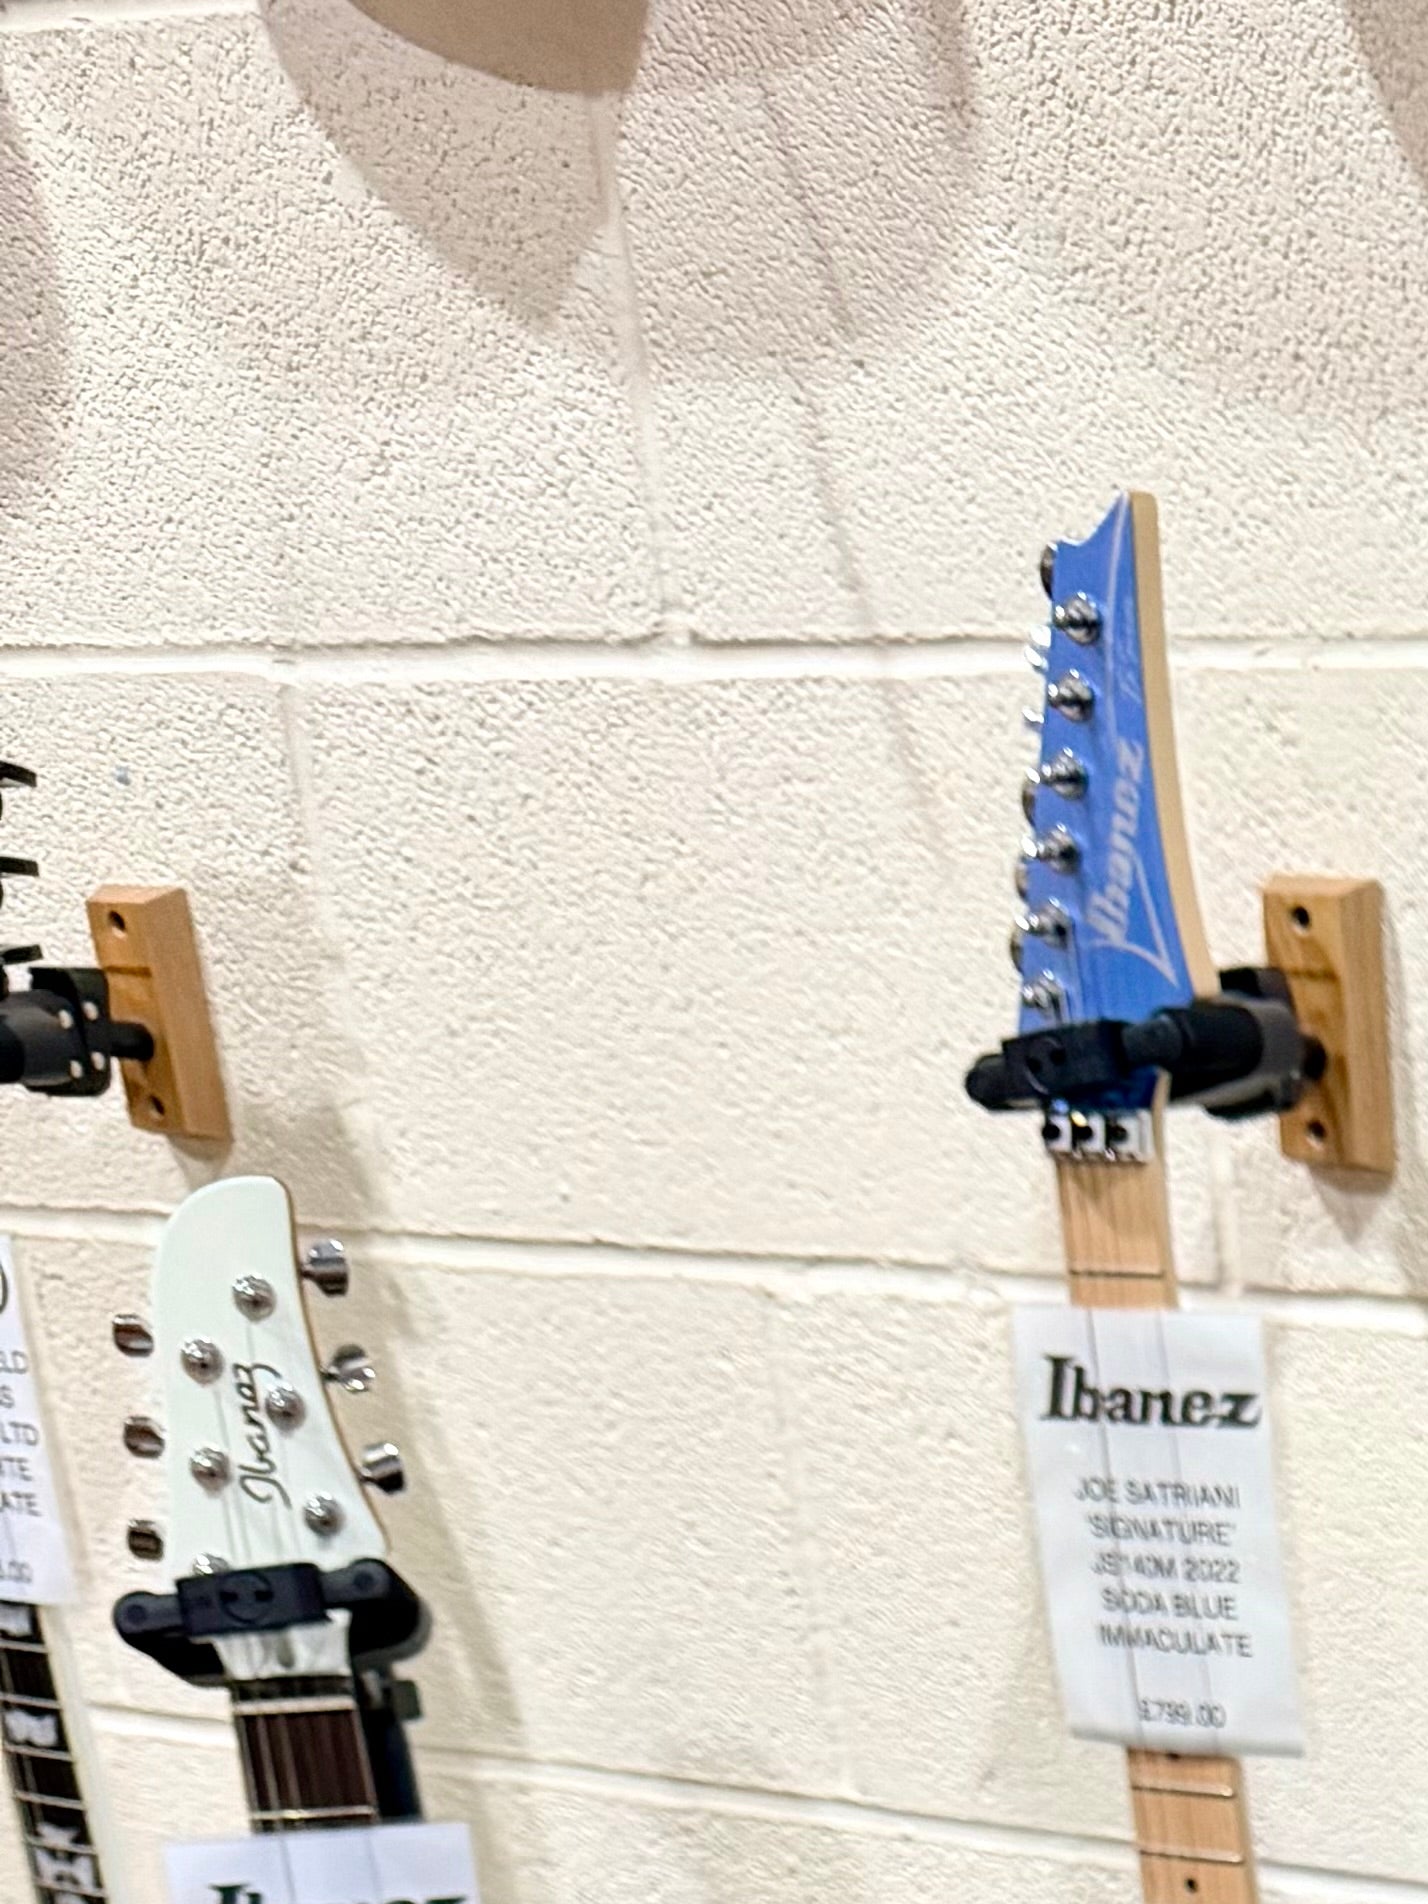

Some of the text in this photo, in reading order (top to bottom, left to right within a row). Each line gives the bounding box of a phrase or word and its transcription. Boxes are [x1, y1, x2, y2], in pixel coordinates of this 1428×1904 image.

[1040, 1353, 1262, 1429] Ibanez
[233, 1363, 292, 1509] Ibanez
[1075, 1477, 1240, 1509] JOE SATRIANI
[1183, 1556, 1240, 1584] 2022
[1101, 1589, 1238, 1621] SODA BLUE
